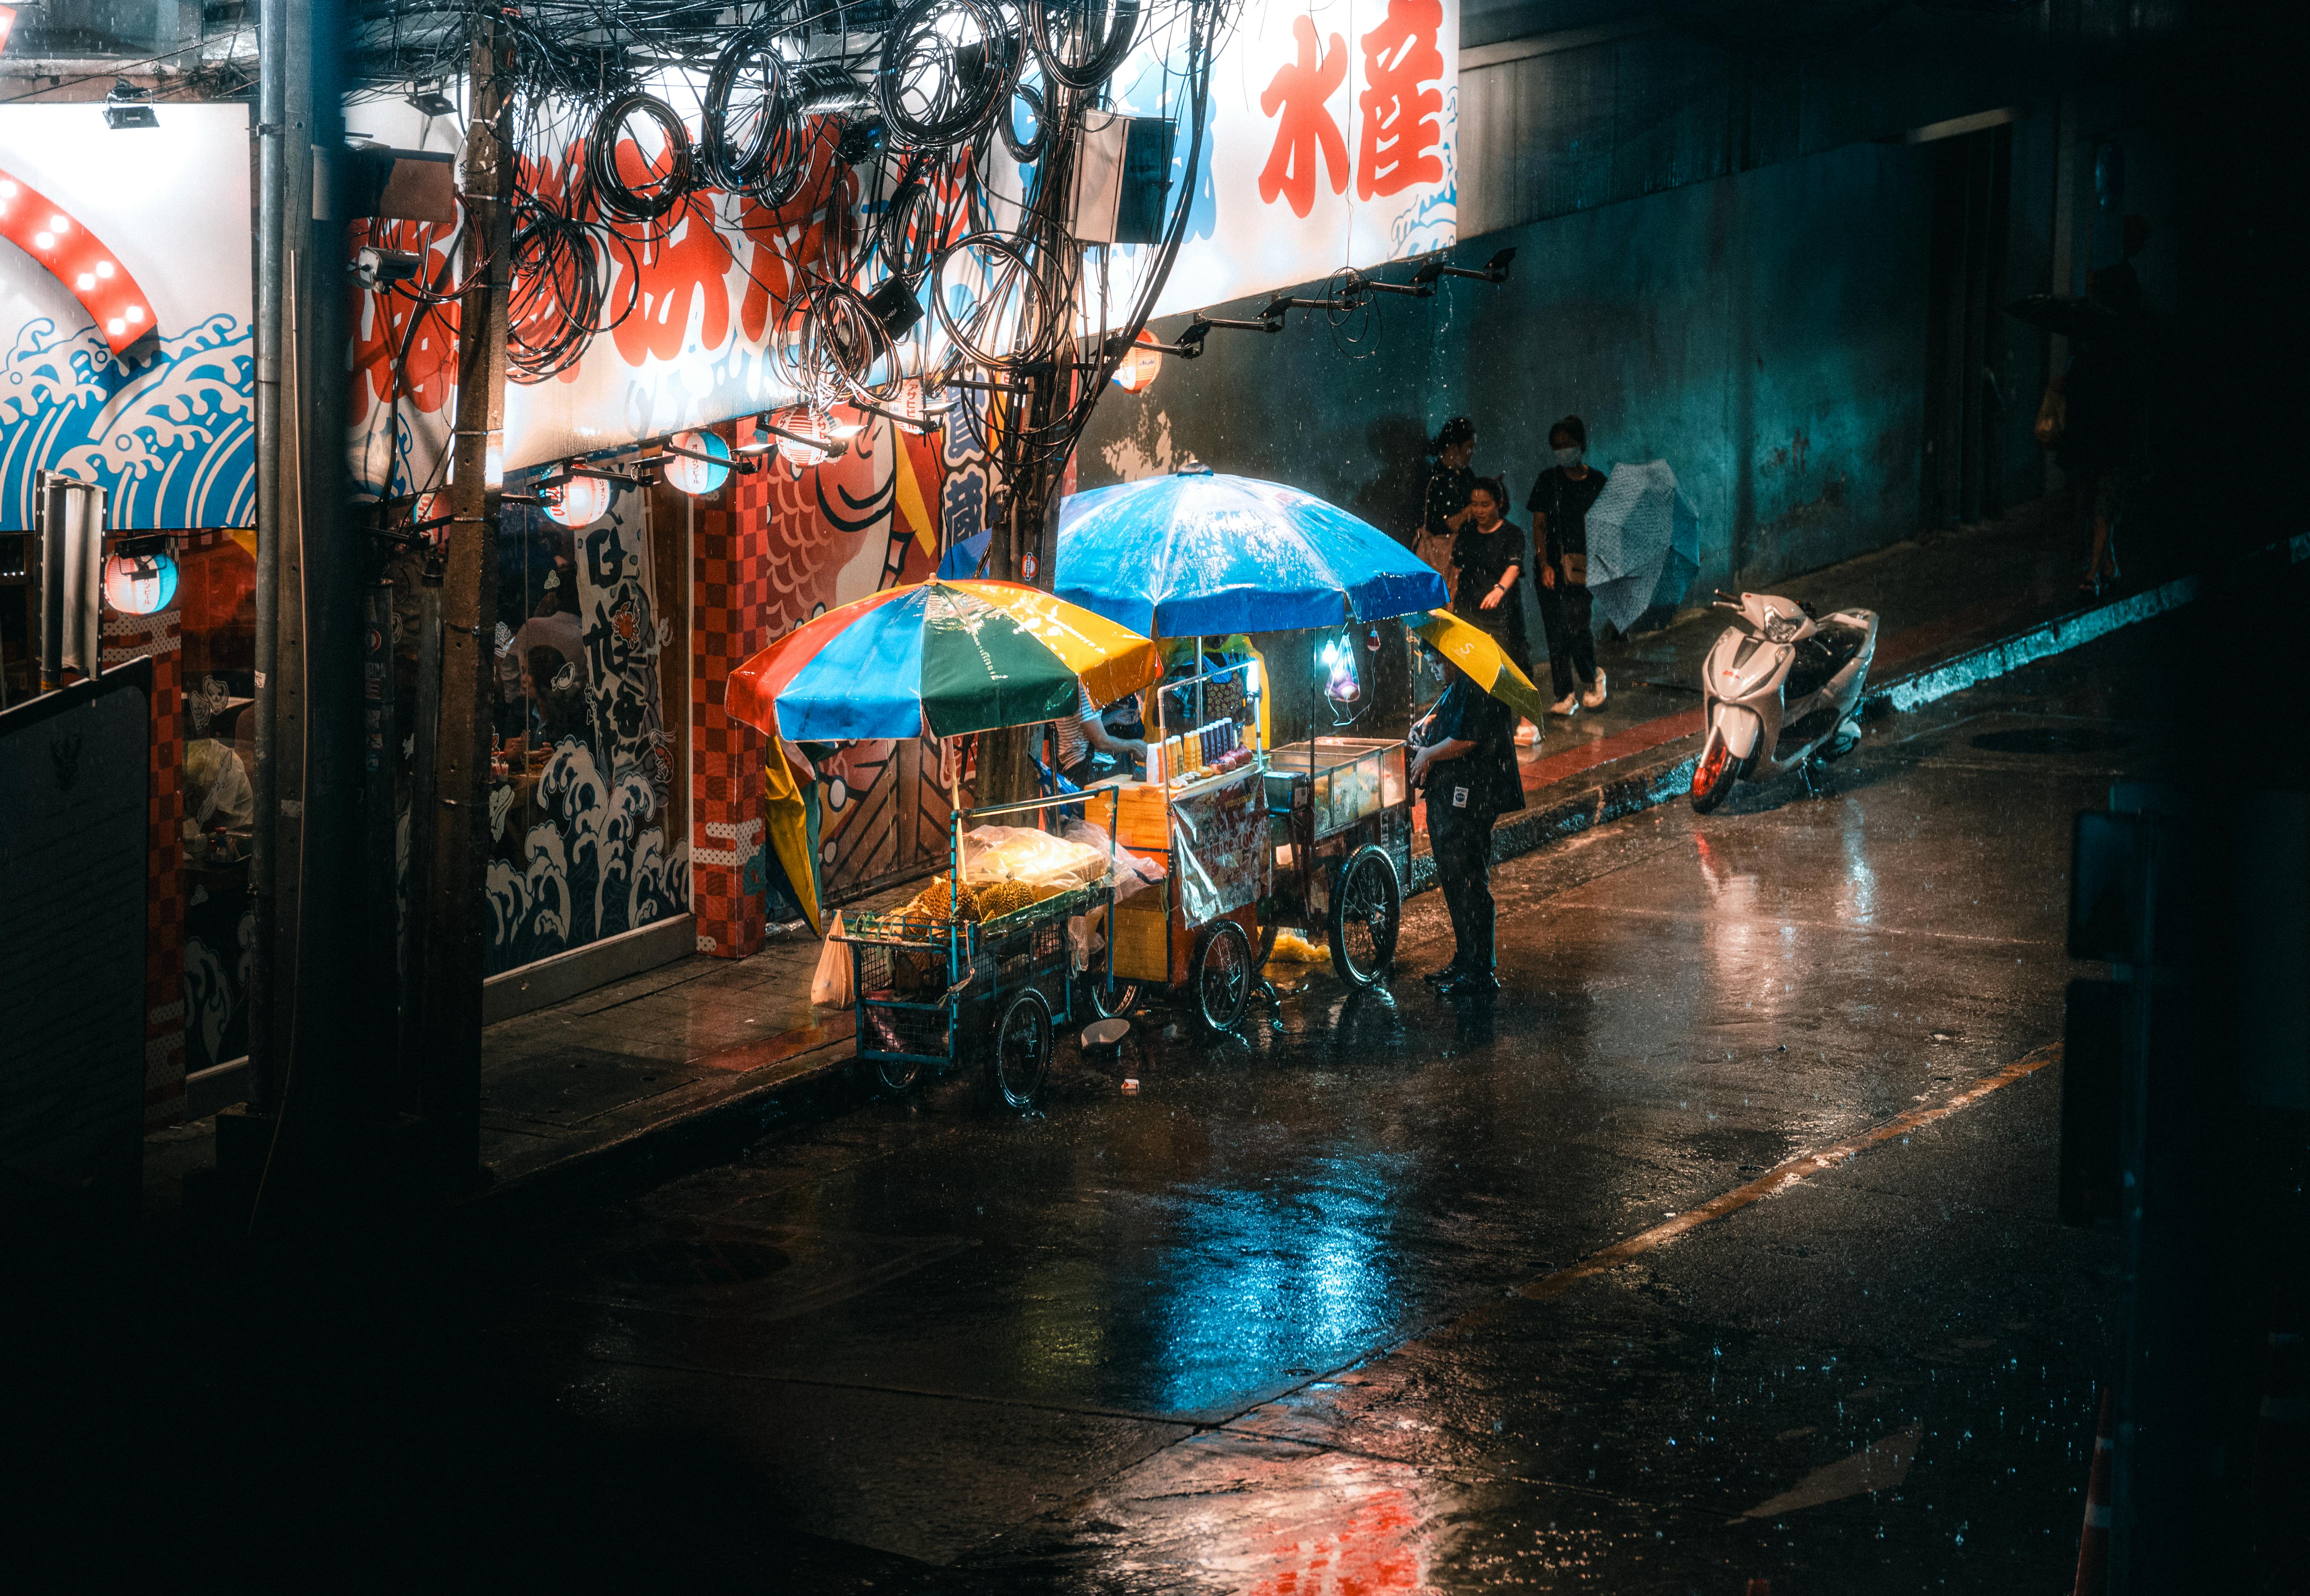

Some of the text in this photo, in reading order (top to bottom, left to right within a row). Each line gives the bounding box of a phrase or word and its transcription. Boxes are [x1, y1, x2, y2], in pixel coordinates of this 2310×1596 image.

[1258, 0, 1443, 218] 水産
[907, 384, 919, 430] アサヒビル
